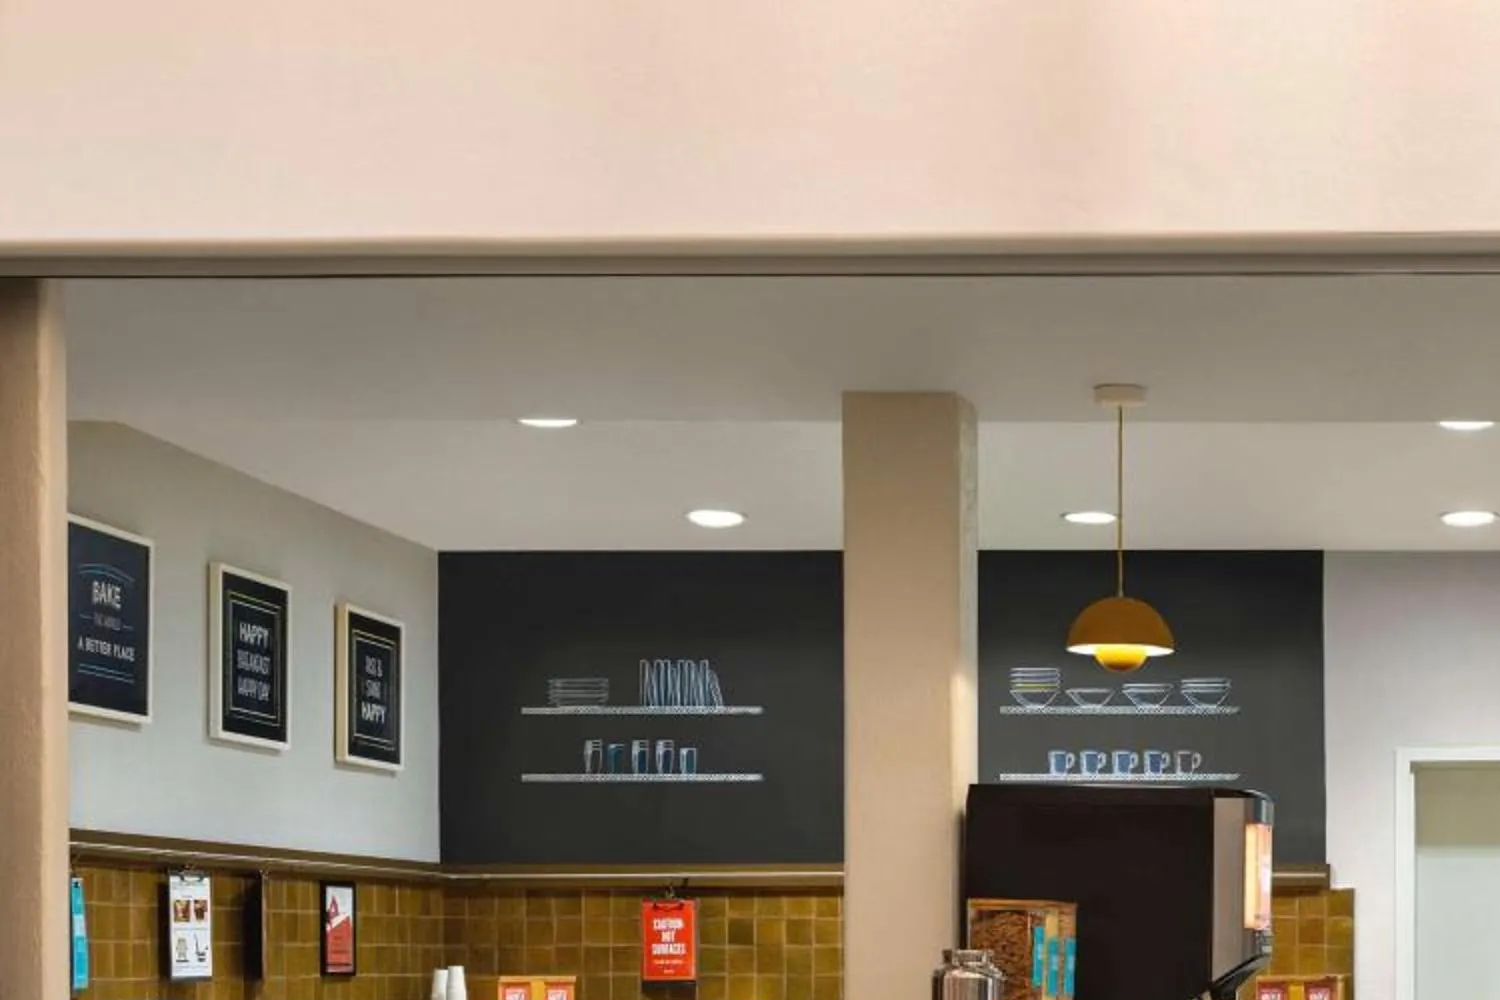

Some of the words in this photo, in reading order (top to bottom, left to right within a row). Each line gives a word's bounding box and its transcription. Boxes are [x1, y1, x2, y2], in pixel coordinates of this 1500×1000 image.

[92, 580, 121, 609] BAKE
[239, 621, 269, 649] HAPPY
[77, 636, 84, 651] A
[85, 637, 112, 657] BETTER
[113, 643, 135, 662] PLACE
[361, 700, 386, 724] HAPPY
